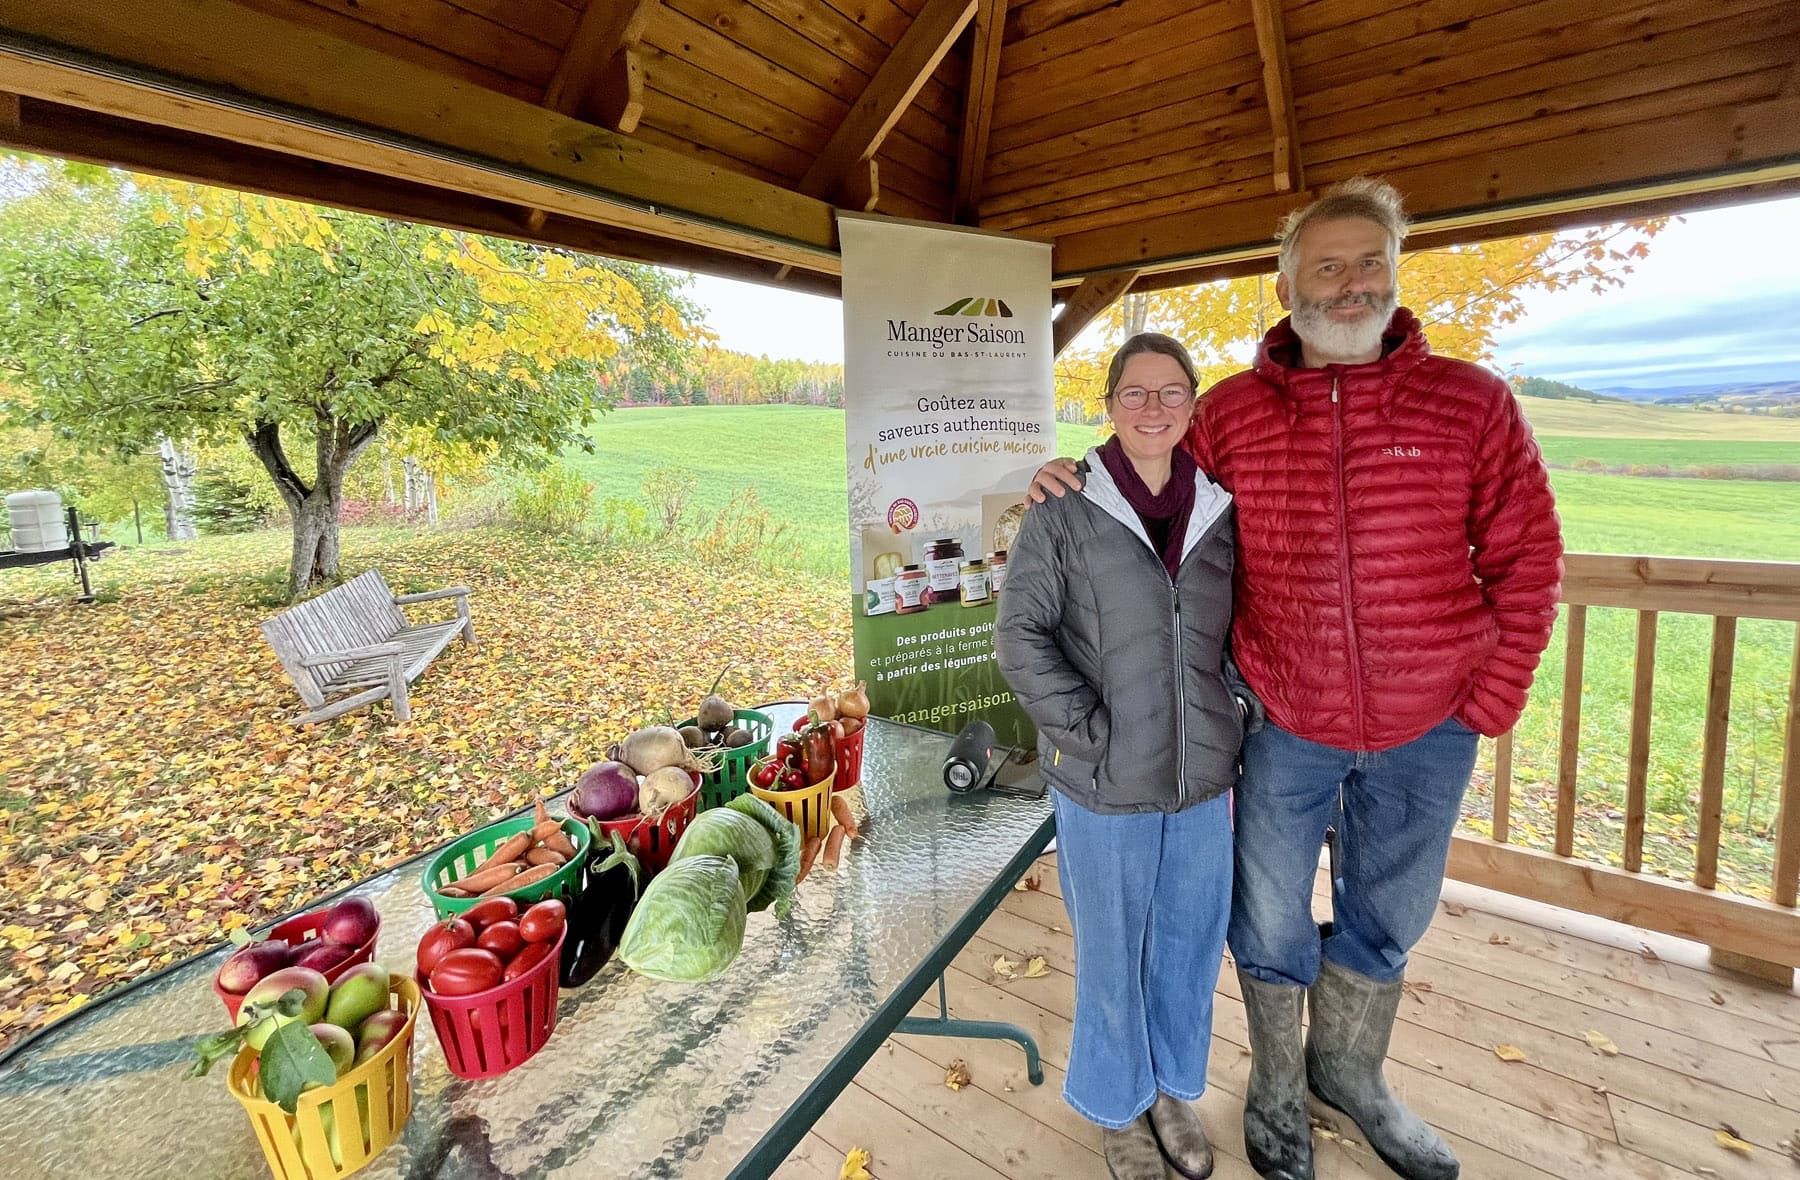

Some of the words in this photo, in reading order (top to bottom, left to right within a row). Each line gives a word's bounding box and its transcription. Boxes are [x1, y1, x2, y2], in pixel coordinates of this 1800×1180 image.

[887, 320, 964, 349] Manger
[967, 323, 1025, 344] Saison
[887, 350, 927, 358] CUISINE
[917, 395, 975, 413] Goûtez
[979, 398, 1006, 410] aux
[878, 420, 939, 442] saveurs
[943, 416, 1040, 436] authentiques
[863, 442, 907, 475] d'une
[910, 439, 947, 459] vraie
[952, 436, 1001, 454] cuisine
[1003, 436, 1047, 456] maison
[896, 634, 917, 647] Des
[920, 627, 967, 646] produits
[870, 656, 881, 667] et
[885, 646, 932, 667] préparés
[935, 645, 942, 655] à
[945, 642, 955, 654] la
[958, 639, 988, 653] ferme
[876, 671, 884, 682] à
[887, 665, 918, 681] partir
[921, 659, 941, 673] des
[944, 653, 989, 671] légumes
[990, 650, 997, 660] d
[888, 690, 1017, 724] mangersaison.
